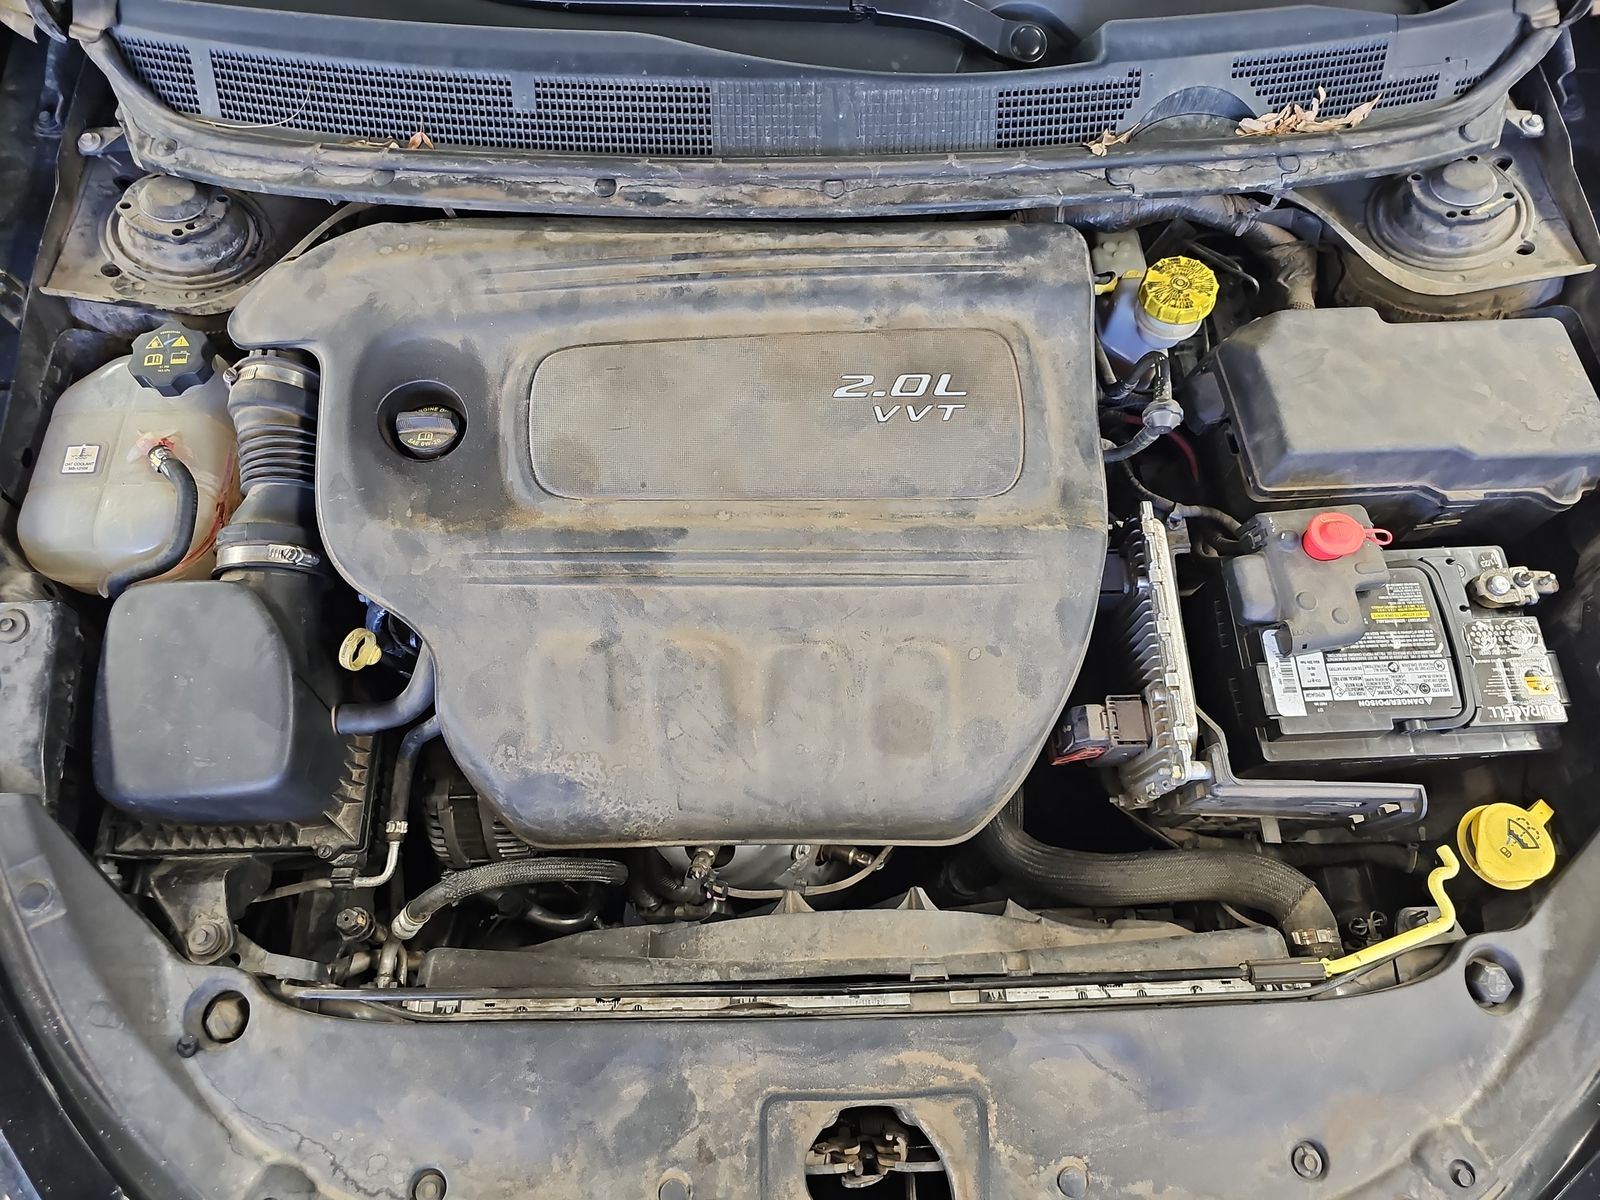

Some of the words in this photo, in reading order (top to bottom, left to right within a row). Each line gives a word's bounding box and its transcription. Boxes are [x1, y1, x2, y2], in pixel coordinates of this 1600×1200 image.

[832, 373, 967, 398] 2.0L
[873, 404, 966, 423] VVT
[407, 438, 419, 446] SAE
[1358, 698, 1425, 706] DANGER/POISON
[1487, 704, 1562, 718] DURACELL
